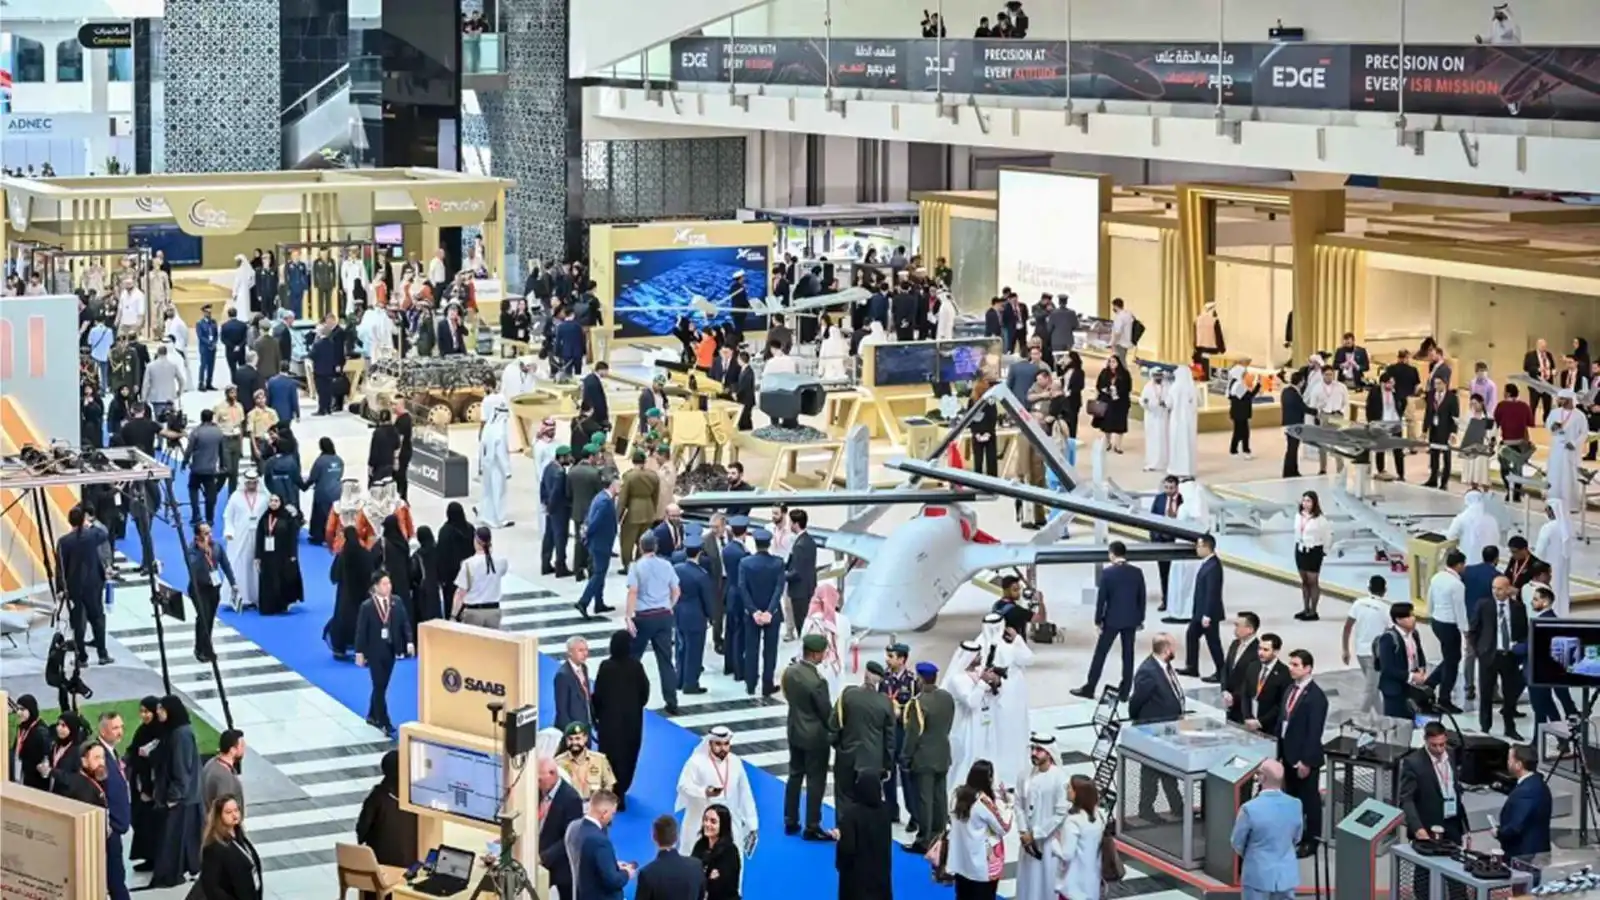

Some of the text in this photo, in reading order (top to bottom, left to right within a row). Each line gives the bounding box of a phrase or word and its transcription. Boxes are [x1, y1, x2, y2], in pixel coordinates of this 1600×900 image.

[681, 52, 708, 67] EDGE
[984, 48, 1046, 60] PRECISION AT
[1365, 54, 1465, 71] PRECSION ON
[984, 66, 1012, 78] EVERY
[1272, 66, 1326, 88] EDGE
[1411, 77, 1432, 92] ISR
[1435, 78, 1500, 95] MISSION
[8, 118, 52, 129] ADNEC
[464, 677, 506, 697] SAAB
